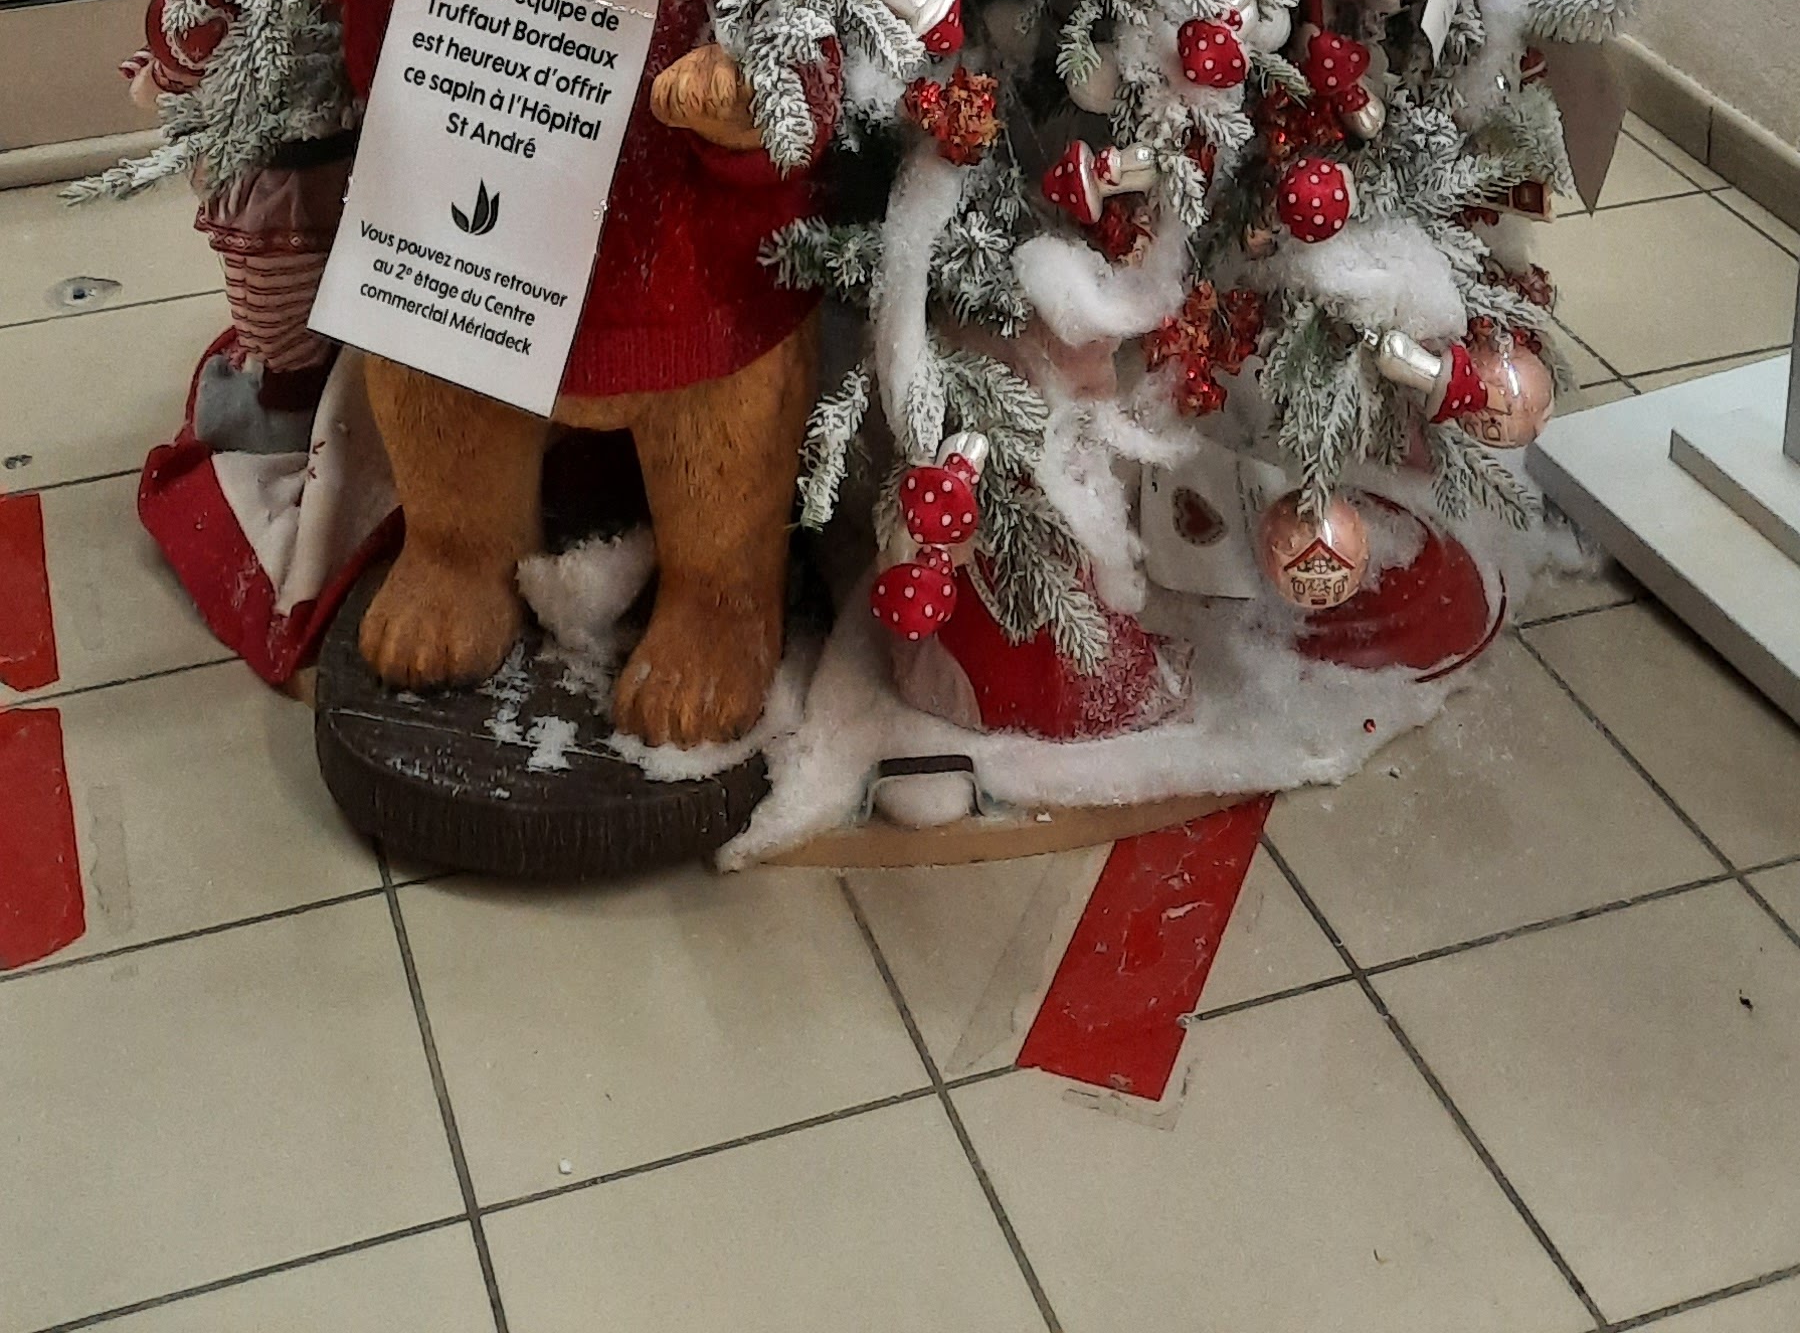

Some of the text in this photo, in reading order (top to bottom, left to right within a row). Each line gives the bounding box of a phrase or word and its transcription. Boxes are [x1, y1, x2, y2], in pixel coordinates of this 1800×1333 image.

[512, 19, 619, 70] Bordeaux
[591, 7, 619, 31] de
[404, 66, 602, 141] ce sapin à l'Hôpital
[412, 31, 612, 105] est heureux d'offrir
[446, 111, 537, 158] St André
[360, 220, 568, 308] Vous pouvez nous retrouver
[373, 257, 394, 275] au
[413, 270, 459, 300] étage
[460, 289, 482, 307] du
[484, 295, 536, 327] Centre
[360, 283, 533, 355] commercial Mériadeck
